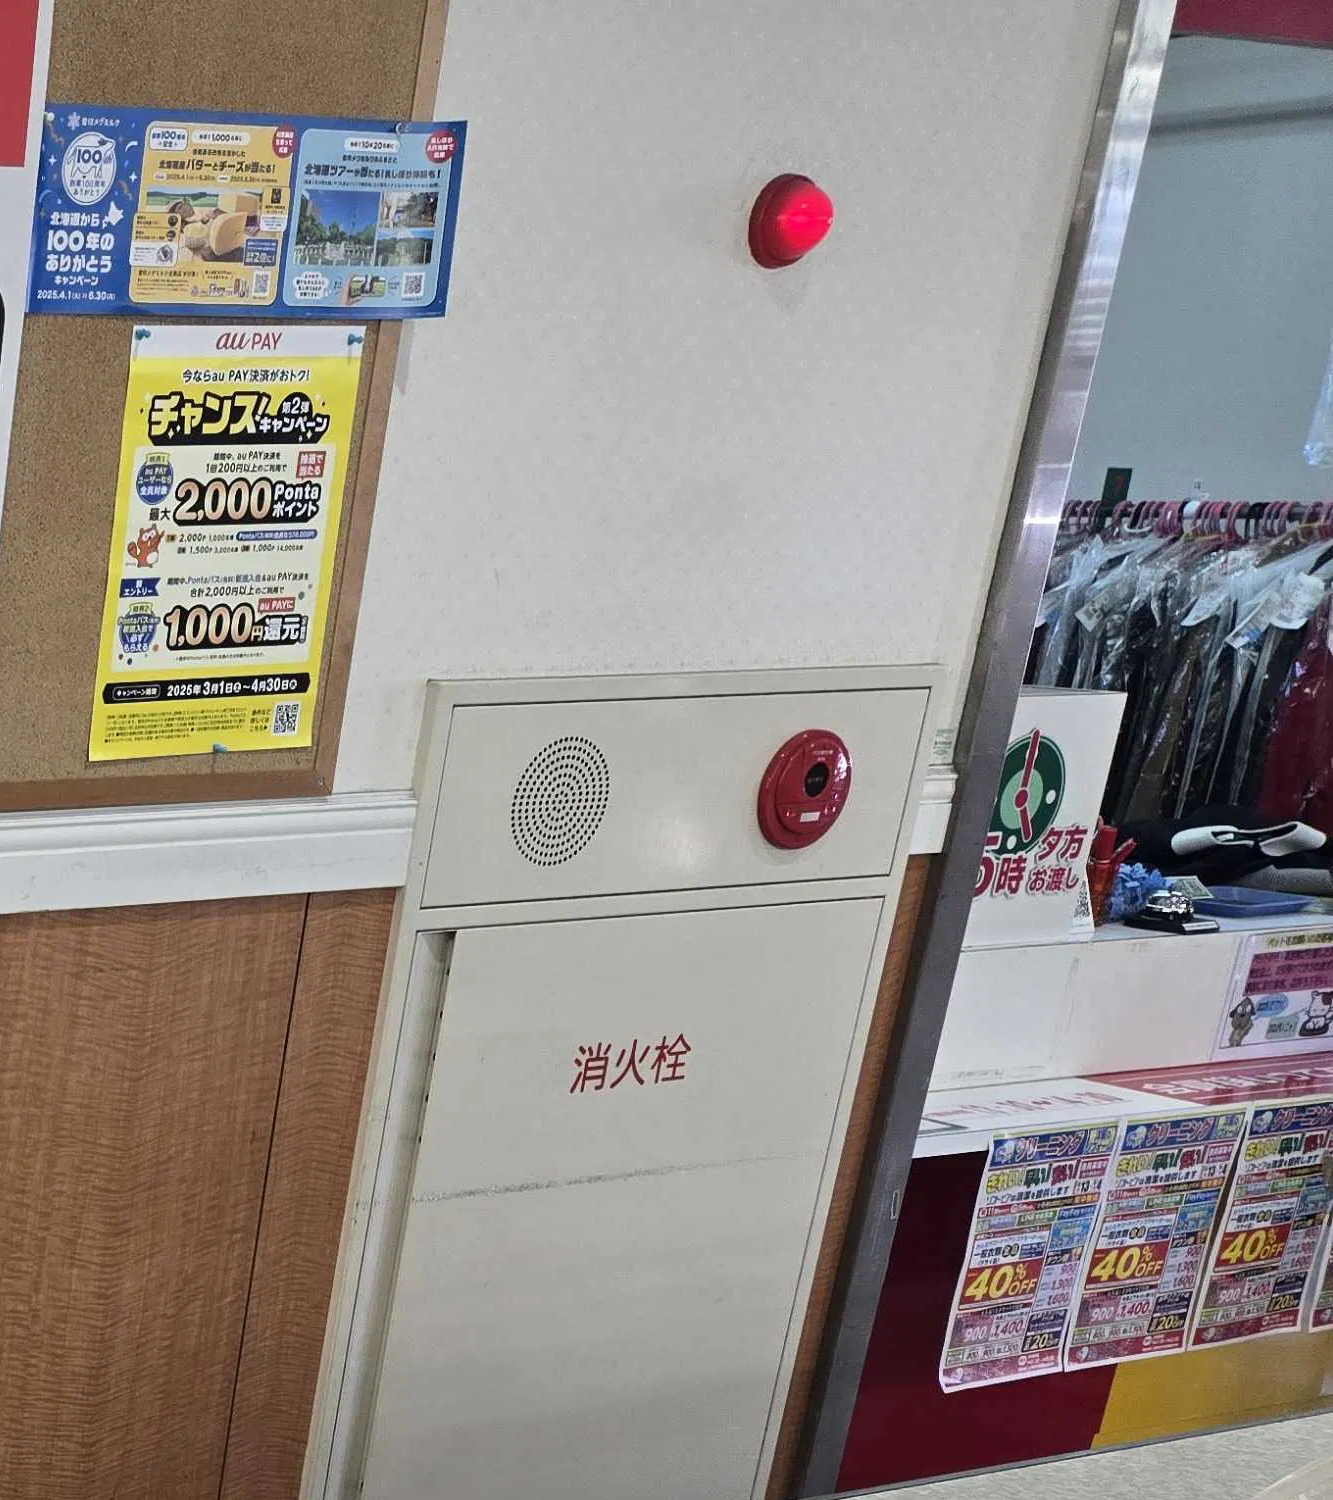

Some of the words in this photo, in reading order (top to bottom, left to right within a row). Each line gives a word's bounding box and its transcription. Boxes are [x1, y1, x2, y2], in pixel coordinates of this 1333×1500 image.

[46, 254, 113, 274] ありがとう
[252, 332, 283, 350] PAY
[259, 415, 330, 435] キャンペーン
[175, 479, 273, 523] 2,000
[274, 484, 319, 501] Ponta
[149, 508, 171, 521] 最大
[273, 502, 318, 518] ポイント
[122, 586, 154, 596] エントリー
[569, 1033, 692, 1094] 消火栓
